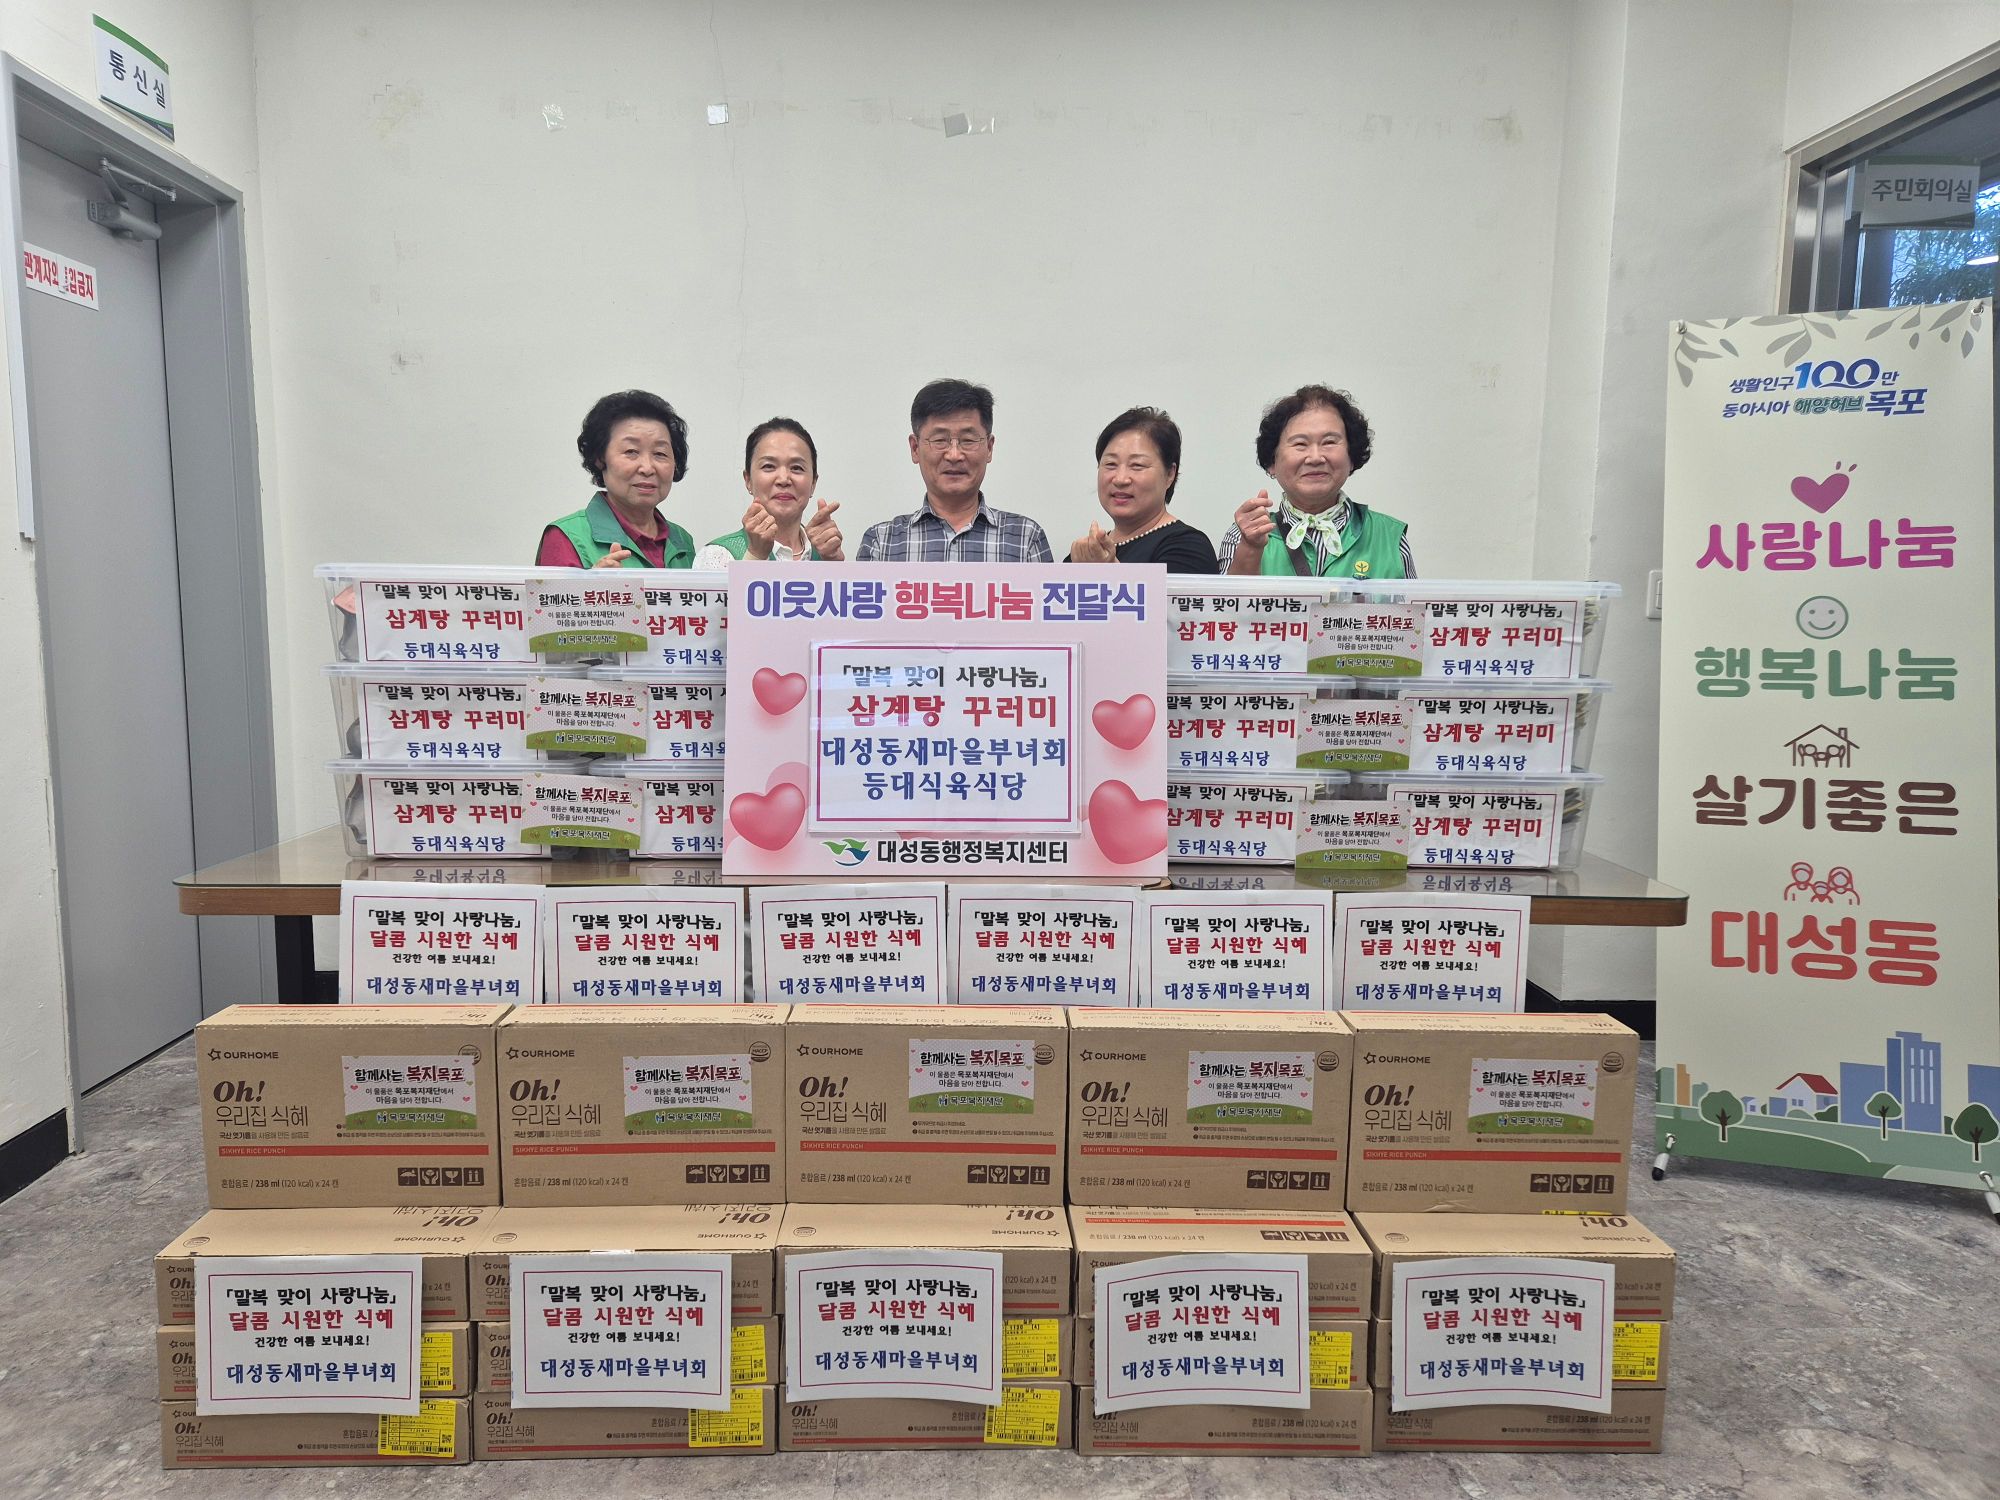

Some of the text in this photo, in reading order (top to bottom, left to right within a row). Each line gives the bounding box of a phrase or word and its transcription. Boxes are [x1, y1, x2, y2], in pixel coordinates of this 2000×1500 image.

[1872, 178, 1972, 203] 주민회의실
[62, 266, 94, 301] 입금지
[1730, 376, 1794, 393] 생활인구
[1723, 389, 1927, 418] 동아시아 해양허브 목포
[1696, 518, 1957, 571] 사랑나눔
[418, 585, 447, 599] 맞이
[455, 586, 519, 601] 사랑나눔」
[539, 590, 635, 606] 함께사는 복지목포
[748, 581, 1144, 620] 이웃사랑 행복나눔 전달식
[1213, 598, 1239, 612] 맞이
[1247, 598, 1307, 612] 사랑나눔」
[1467, 603, 1493, 617] 맞이
[1501, 603, 1562, 618] 사랑나눔」
[386, 609, 523, 630] 삼계탕 꾸러미
[1323, 615, 1413, 629] 함께사는 복지목포
[1177, 621, 1307, 641] 삼계탕 꾸러미
[1430, 627, 1562, 647] 삼계탕 꾸러미
[405, 643, 500, 659] 등대식육식당
[1191, 654, 1282, 672] 등대식육식당
[1442, 660, 1534, 675] 등대식육식당
[843, 665, 1046, 688] 「말복 맞이 사랑나눔」
[1695, 647, 1958, 701] 행복나눔
[421, 686, 449, 700] 맞이
[457, 687, 521, 701] 사랑나눔」
[540, 692, 635, 708] 함께사는 복지목포
[847, 695, 1055, 727] 삼계탕 꾸러미
[1459, 700, 1485, 714] 맞이
[1493, 700, 1553, 714] 사랑나눔」
[388, 710, 524, 730] 삼계탕 꾸러미
[1423, 724, 1554, 743] 삼계탕 꾸러미
[407, 742, 502, 758] 등대식육식당
[822, 738, 1065, 766] 대성동새마을부녀회
[1436, 755, 1526, 771] 등대식육식당
[426, 782, 454, 795] 맞이
[863, 772, 1026, 800] 등대식육식당
[1449, 795, 1475, 808] 맞이
[1482, 796, 1542, 810] 사랑나눔」
[1693, 775, 1959, 835] 살기좋은
[394, 805, 457, 823] 삼계탕
[1310, 812, 1399, 826] 함께사는 복지목포
[1412, 817, 1541, 837] 삼계탕 꾸러미
[412, 836, 505, 852] 등대식육식당
[878, 841, 1067, 863] 대성동행정복지센터
[1425, 848, 1515, 864] 등대식육식당
[369, 910, 520, 928] 「말복 맞이 사랑나눔」
[975, 911, 1117, 928] 「말복 맞이 사랑나눔」
[370, 930, 517, 950] 달콤 시원한 식혜
[976, 931, 1114, 949] 달콤 시원한 식혜
[1712, 911, 1940, 986] 대성동
[392, 954, 495, 964] 건강한 여름 보내세요!
[996, 953, 1093, 963] 건강한 여름 보내세요!
[367, 977, 519, 996] 대성동새마을부녀회
[972, 976, 1115, 994] 대성동새마을부녀회
[921, 1050, 1025, 1066] 함께사는 복지목포
[213, 1081, 265, 1102] Oh!
[799, 1077, 848, 1097] Oh!
[217, 1105, 308, 1127] 우리집 식혜
[800, 1101, 886, 1123] 우리집 식혜
[801, 1126, 814, 1135] 국산
[832, 1174, 846, 1182] 238
[846, 1174, 856, 1183] ml
[894, 1175, 903, 1183] 24
[541, 1285, 705, 1302] 「말복 맞이 사랑나눔」
[1422, 1287, 1585, 1308] 「말복 맞이 사랑나눔」
[543, 1307, 703, 1326] 달콤 시원한 식혜
[1424, 1308, 1582, 1331] 달콤 시원한 식혜
[568, 1332, 679, 1343] 건강한 여름 보내세요!
[1446, 1333, 1556, 1344] 건강한 여름 보내세요!
[541, 1358, 705, 1378] 대성동새마을부녀회
[1420, 1358, 1584, 1381] 대성동새마을부녀회
